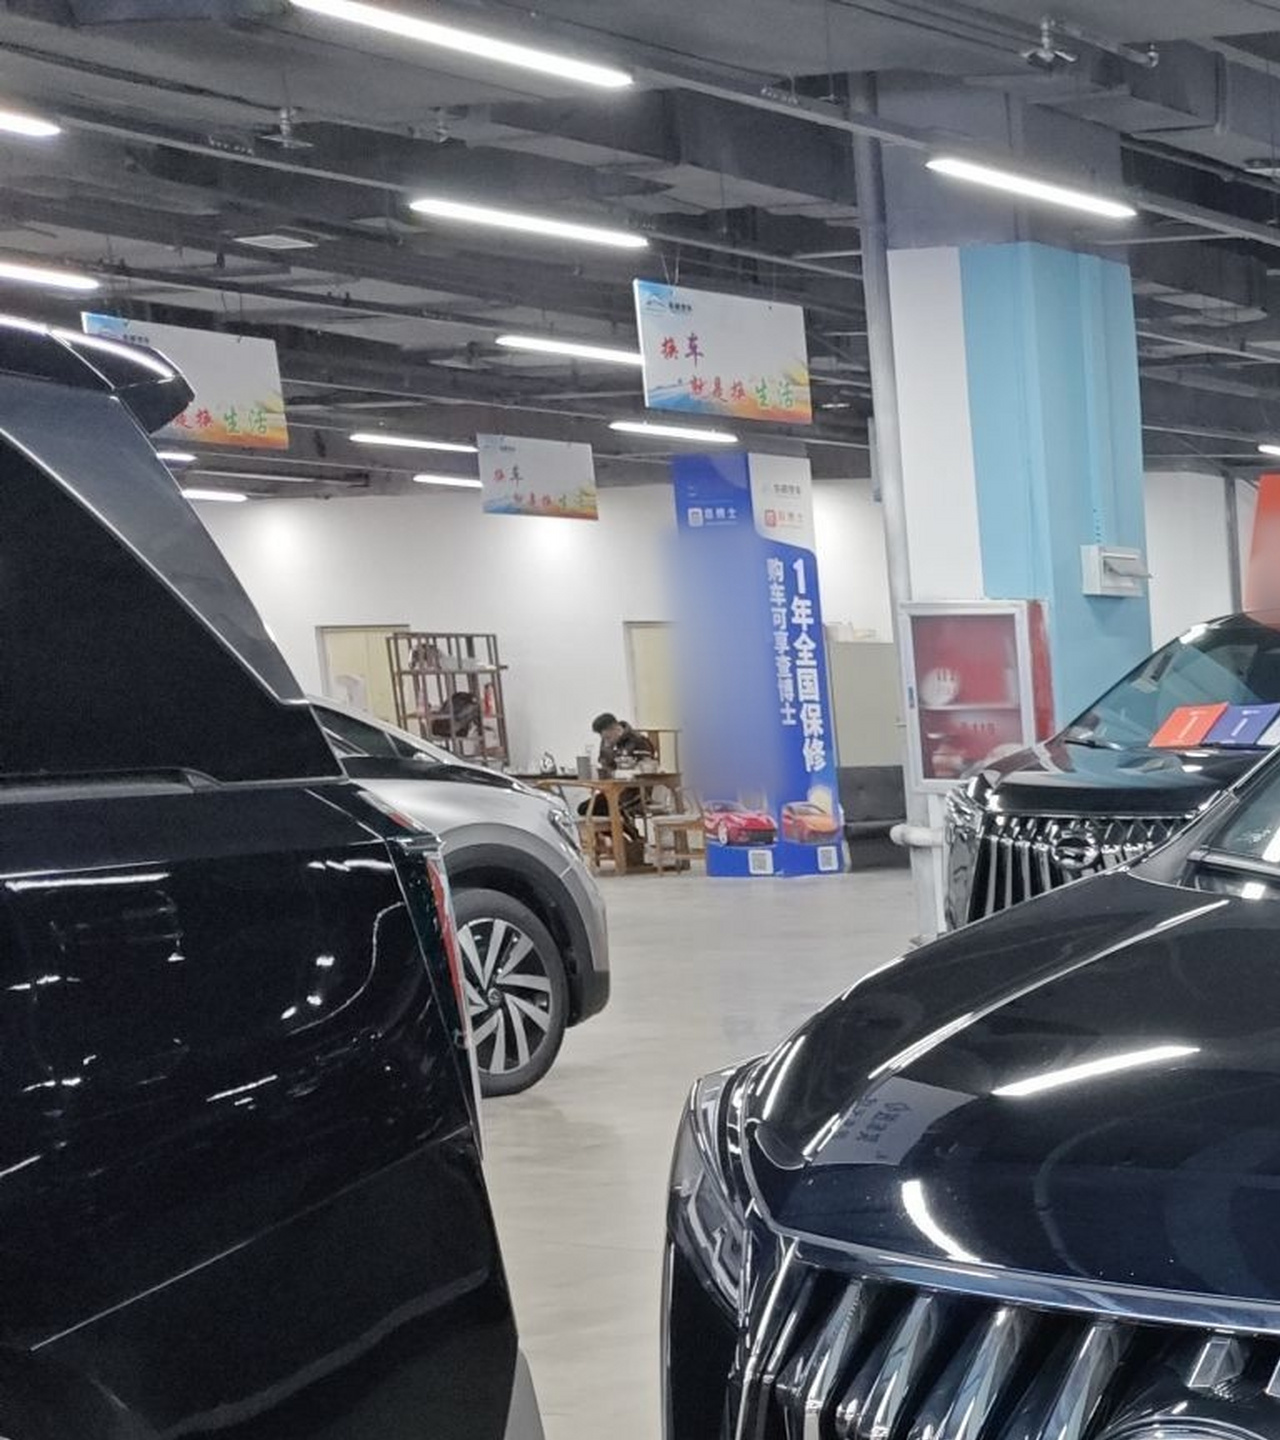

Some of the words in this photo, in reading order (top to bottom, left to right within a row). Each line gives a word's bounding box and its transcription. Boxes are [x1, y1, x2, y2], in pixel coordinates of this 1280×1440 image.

[660, 333, 704, 367] 换车
[766, 558, 798, 726] 购车可享查博士
[791, 558, 827, 772] 1年全国保修
